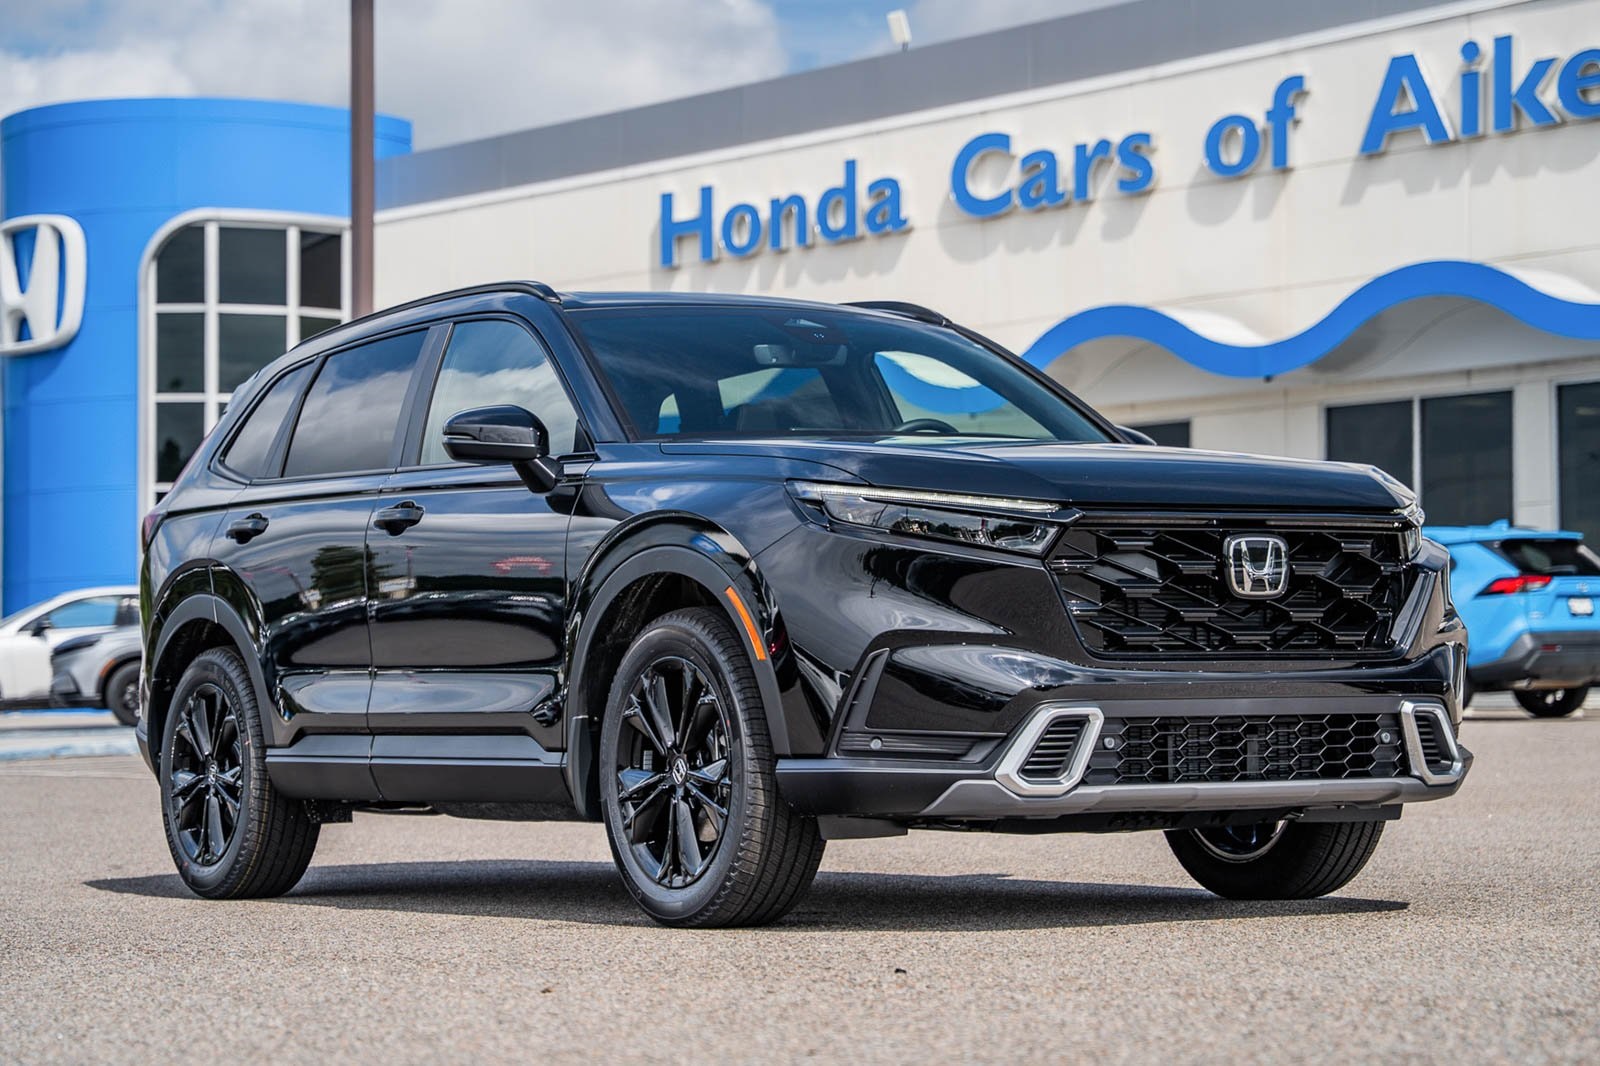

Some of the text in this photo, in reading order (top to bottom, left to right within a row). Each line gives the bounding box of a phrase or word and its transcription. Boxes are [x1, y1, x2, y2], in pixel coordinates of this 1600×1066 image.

[659, 34, 1600, 270] Honda Cars of Aike
